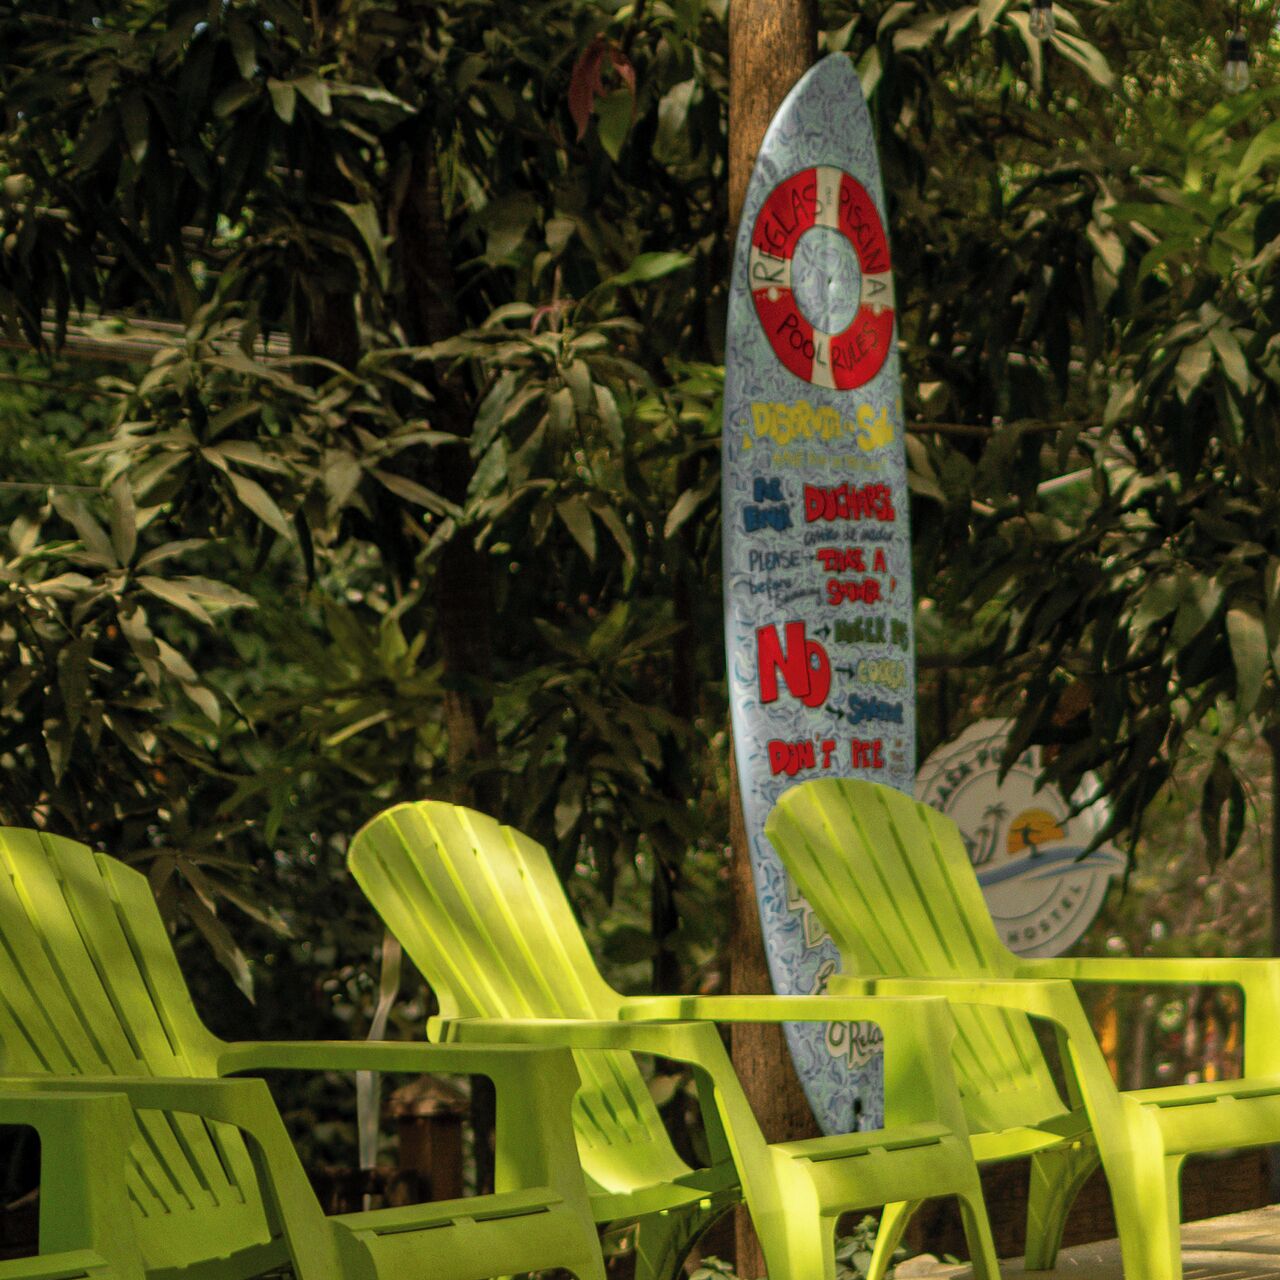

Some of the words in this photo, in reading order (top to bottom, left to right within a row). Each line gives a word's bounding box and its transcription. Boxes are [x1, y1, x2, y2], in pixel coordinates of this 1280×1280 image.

[753, 183, 824, 285] REGLAS
[838, 185, 887, 297] PISCINA
[776, 312, 827, 367] POOL
[831, 320, 880, 372] RULES
[749, 548, 801, 572] PLEASE
[816, 547, 867, 573] TAKE
[872, 547, 887, 574] A
[756, 619, 832, 709] NO
[768, 731, 836, 777] DON'T
[851, 737, 884, 769] PEE
[1007, 884, 1083, 944] HOSTEL
[849, 1021, 885, 1064] Rela
